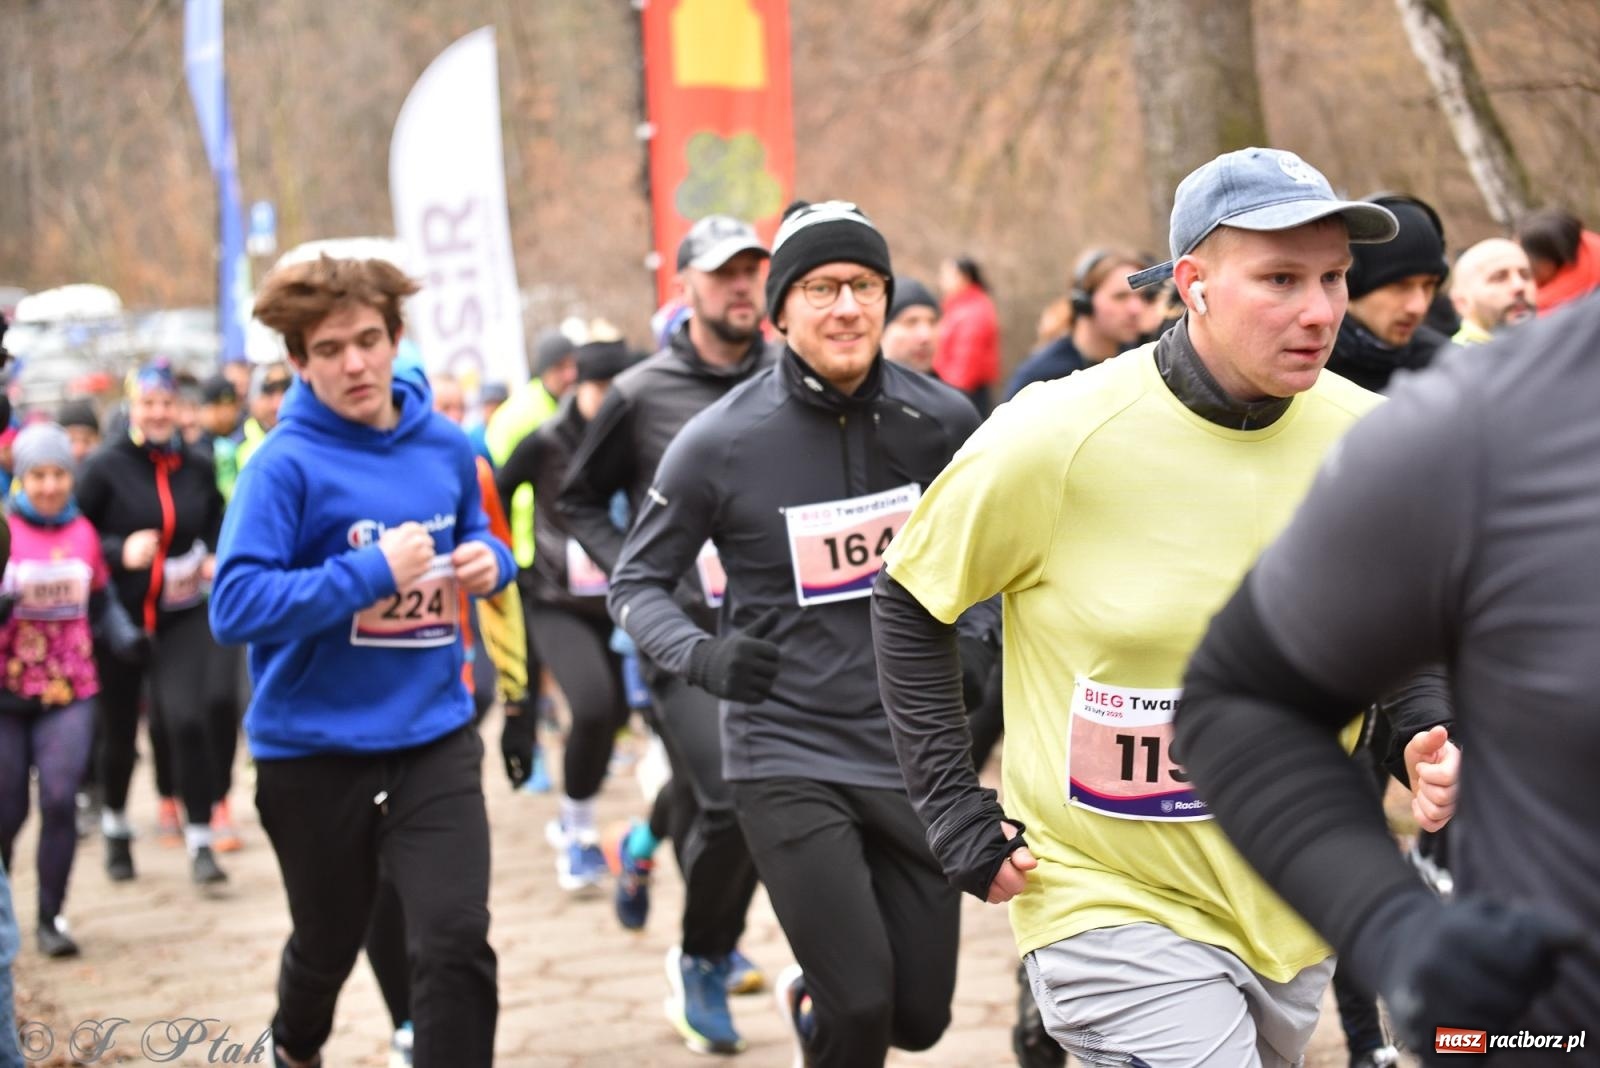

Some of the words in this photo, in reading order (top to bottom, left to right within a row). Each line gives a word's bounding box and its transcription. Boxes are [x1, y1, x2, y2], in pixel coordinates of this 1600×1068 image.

[823, 526, 894, 571] 164
[381, 588, 443, 620] 224
[1085, 687, 1124, 708] BIEG
